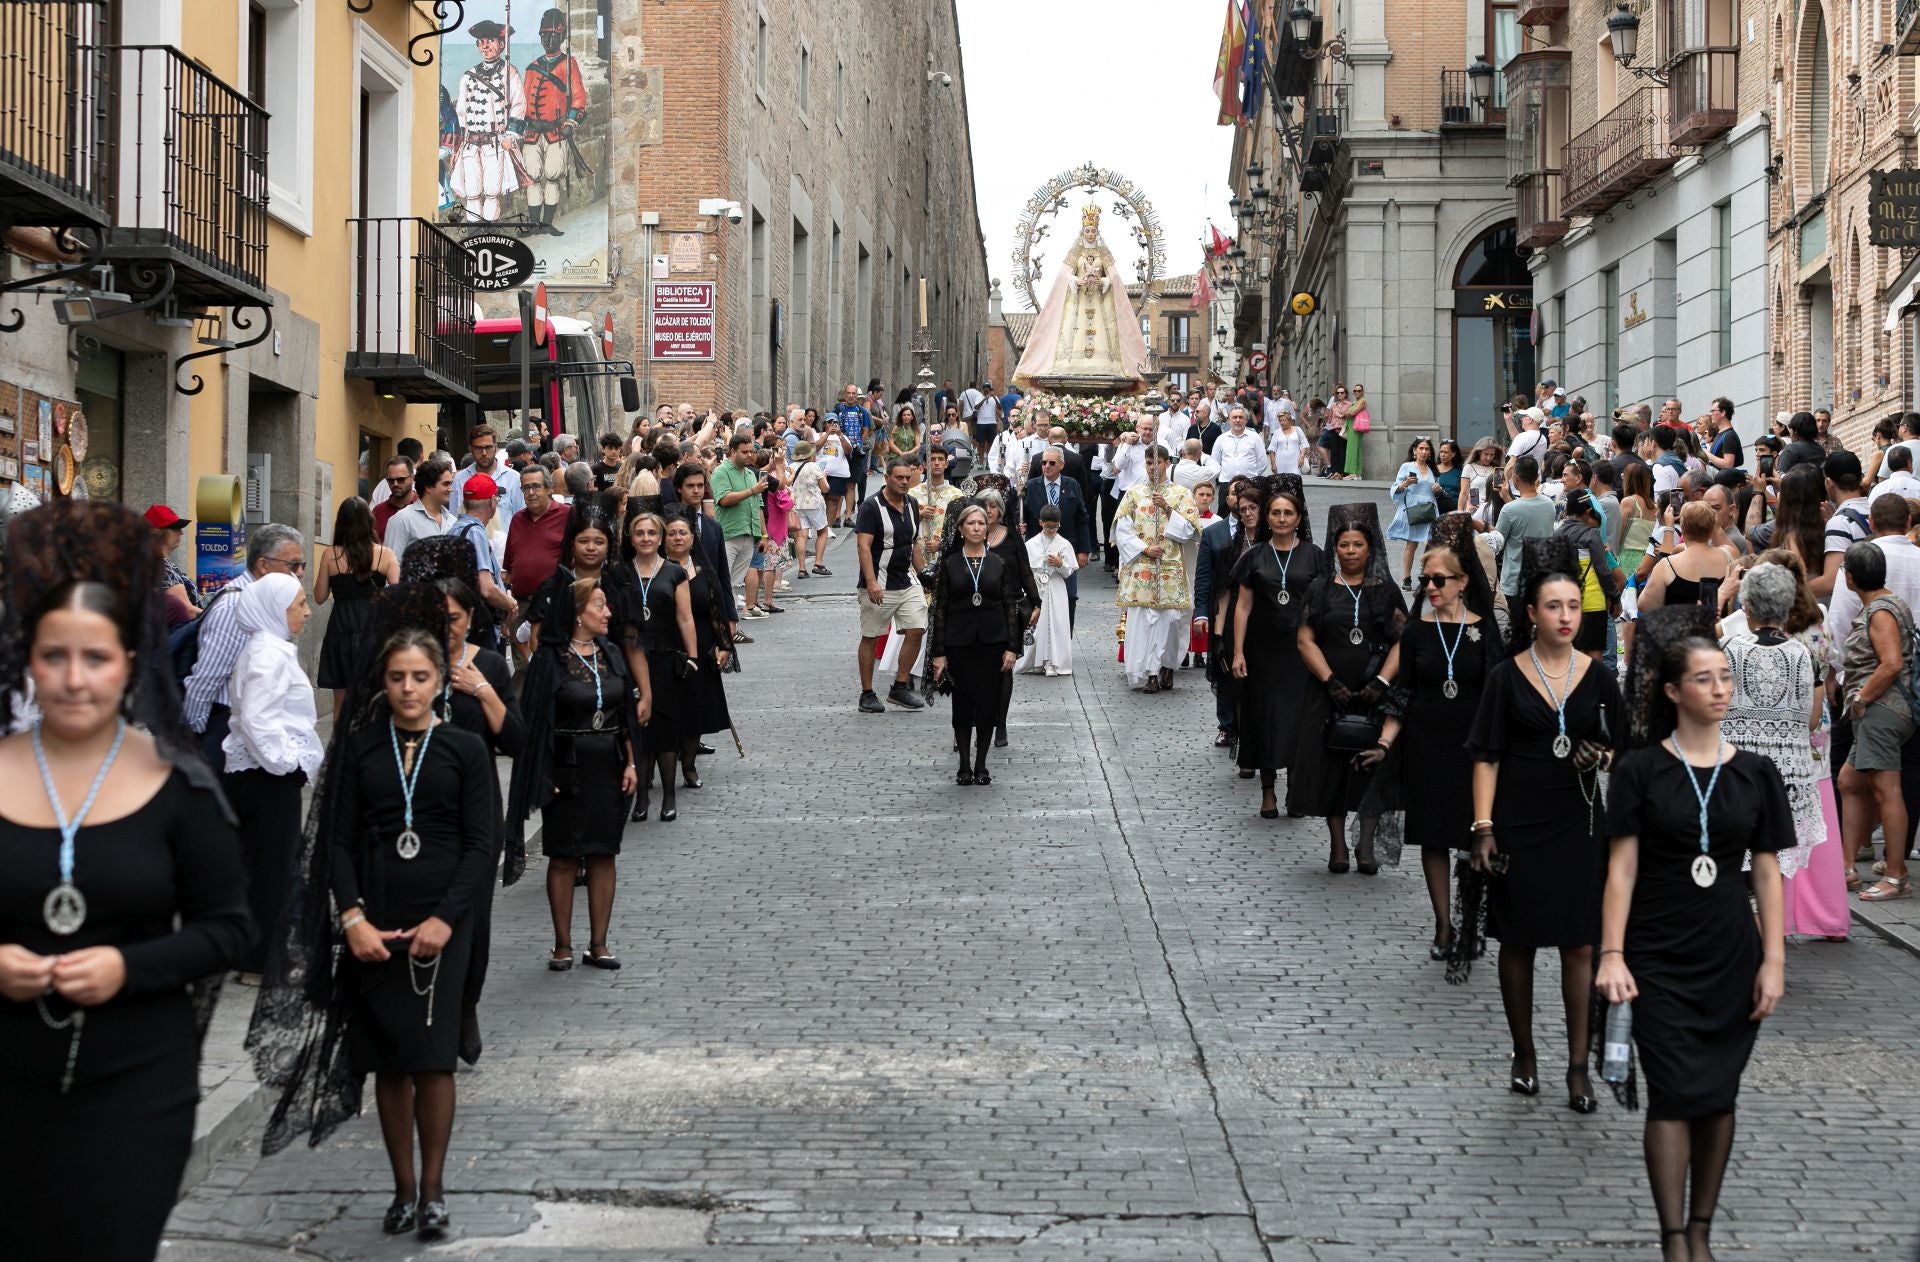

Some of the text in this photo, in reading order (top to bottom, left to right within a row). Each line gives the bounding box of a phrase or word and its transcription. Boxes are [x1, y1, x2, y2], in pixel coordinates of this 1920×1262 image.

[1879, 201, 1918, 219] Maz
[463, 236, 515, 248] RESTAURANTE
[473, 277, 510, 289] TAPAS
[656, 286, 704, 296] BIBLIOTECA
[655, 314, 711, 326] ALCÁZAR DE TOLEDO
[654, 330, 711, 342] MUSEO DEL EJÉRCITO
[200, 544, 228, 552] TOLEDO
